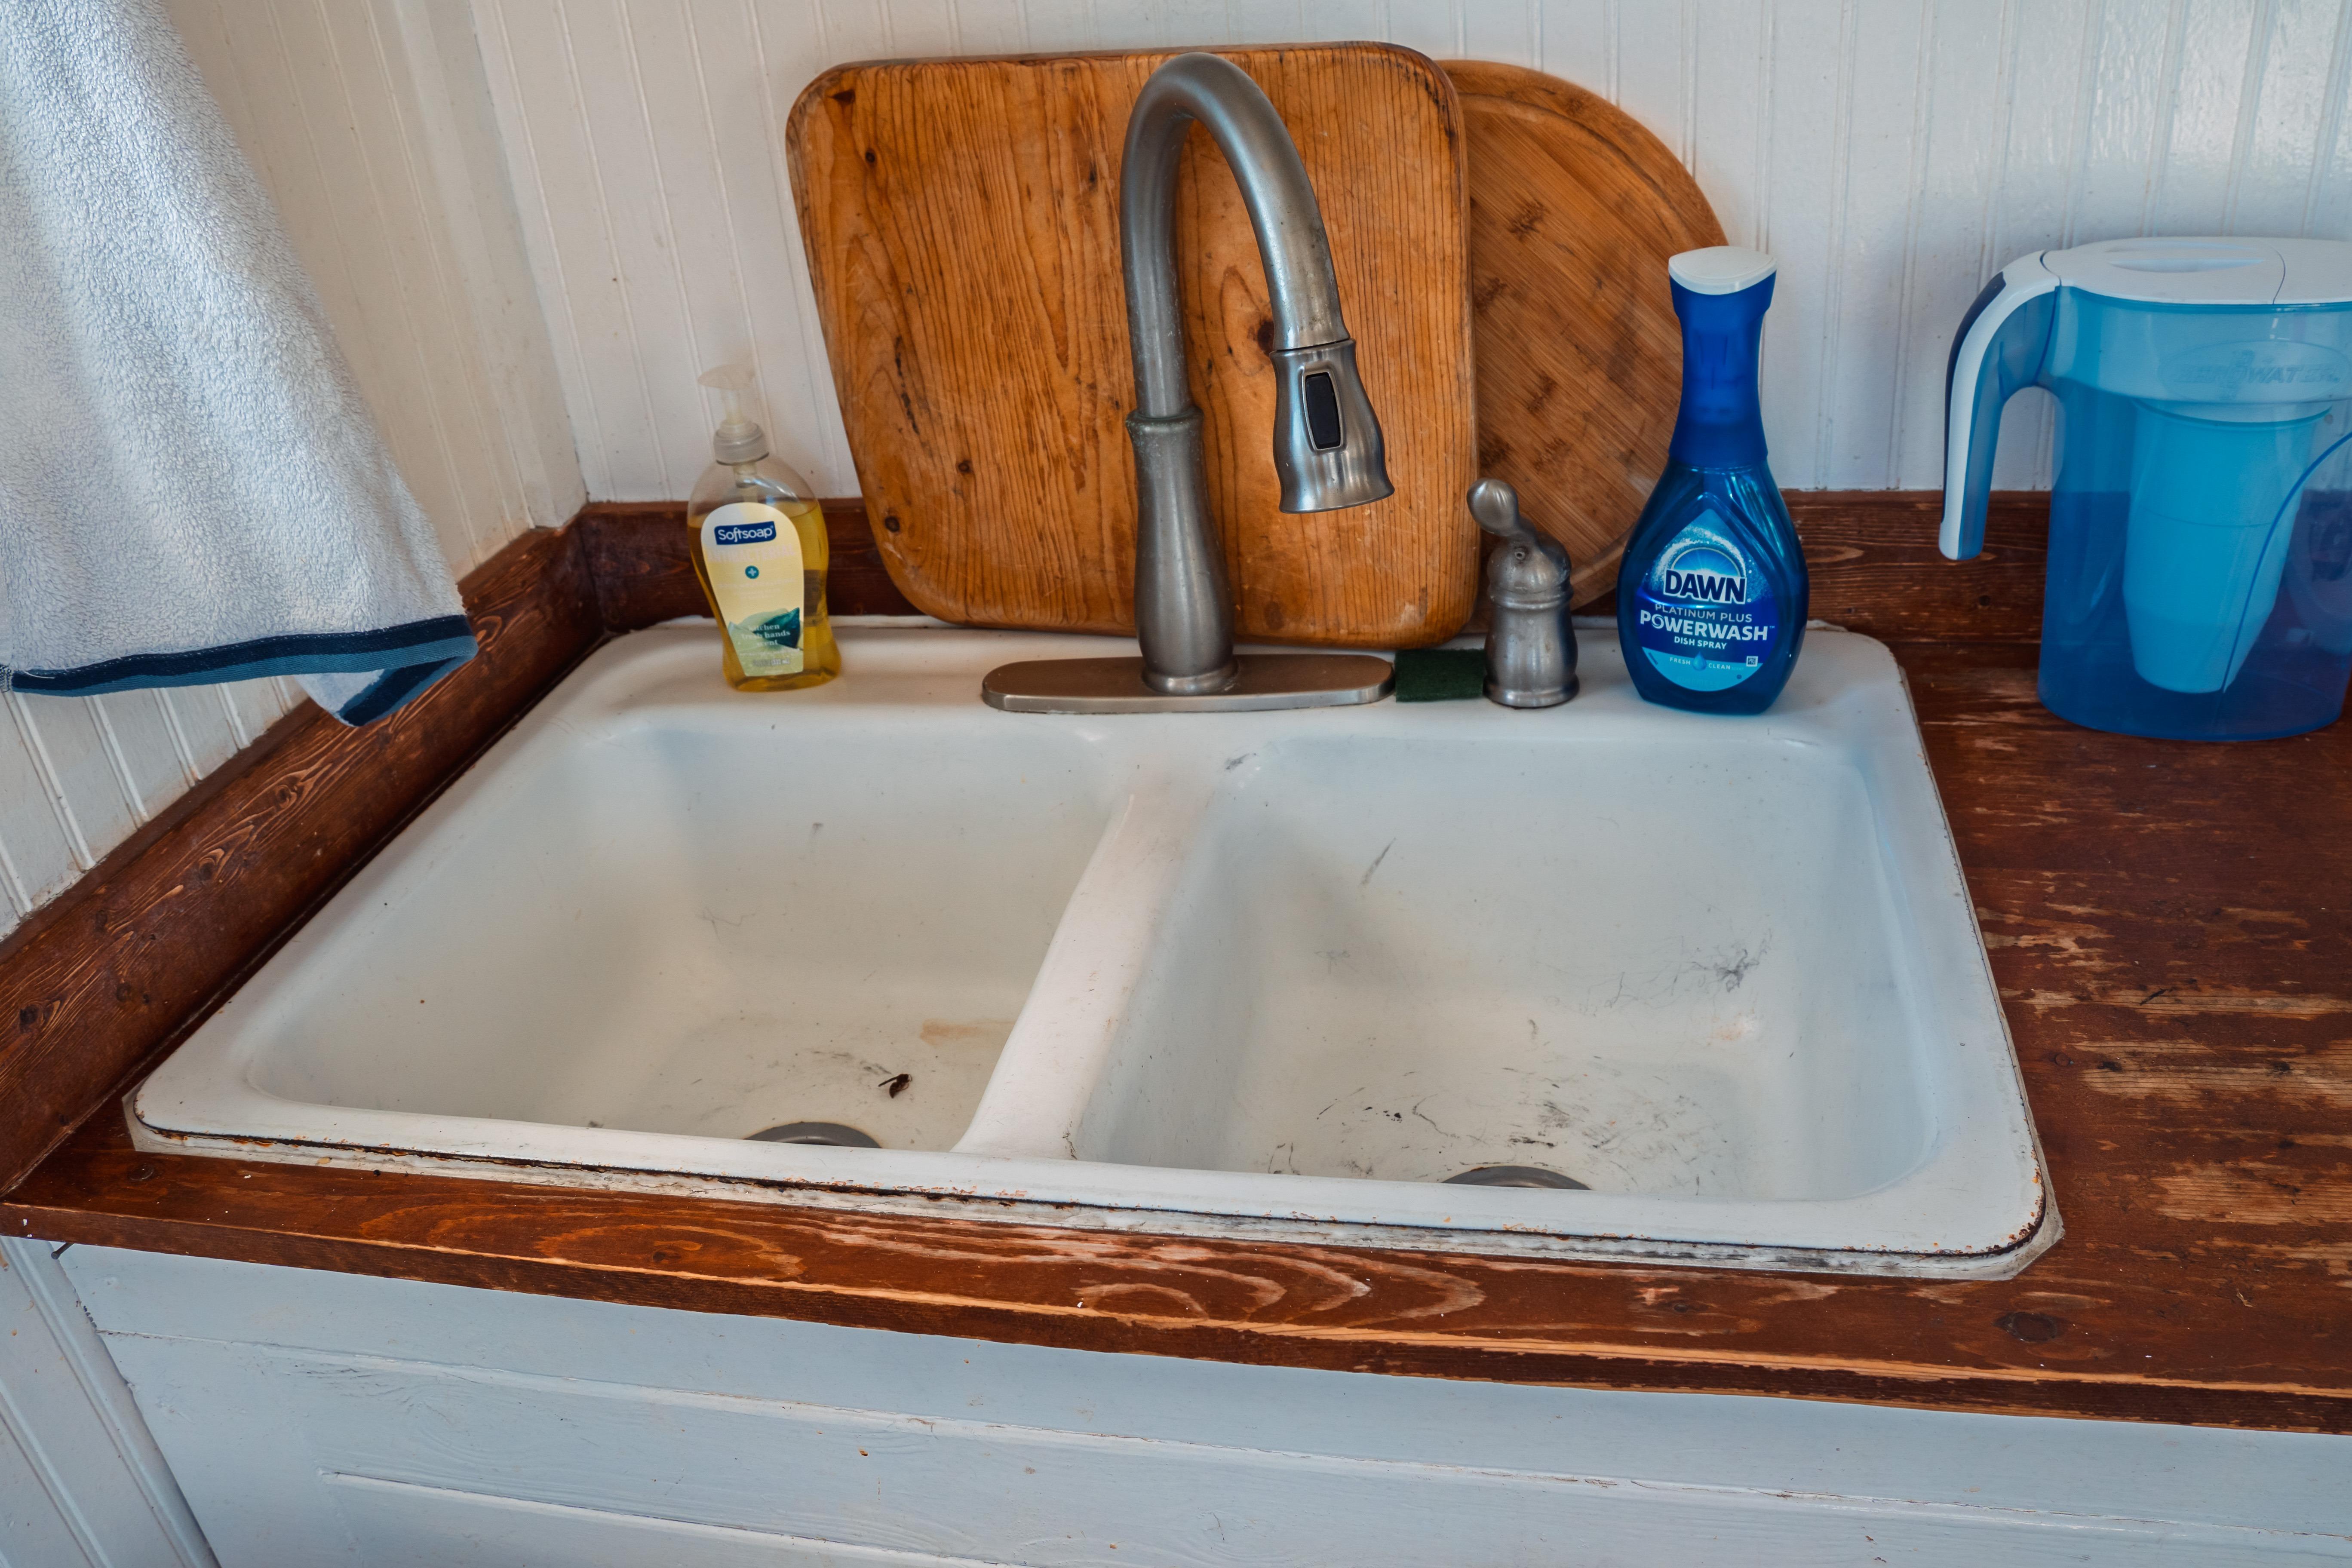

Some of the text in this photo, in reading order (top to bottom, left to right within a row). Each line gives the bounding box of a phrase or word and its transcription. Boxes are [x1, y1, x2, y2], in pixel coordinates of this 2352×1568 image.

[718, 527, 773, 542] Softsoap
[1664, 569, 1747, 604] DAWN
[1655, 604, 1753, 623] PLATINUM PLUS
[1640, 610, 1768, 641] POWERWASH
[765, 630, 790, 638] hands
[1674, 635, 1727, 650] DISH SPRAY
[1670, 657, 1691, 666] FRESH
